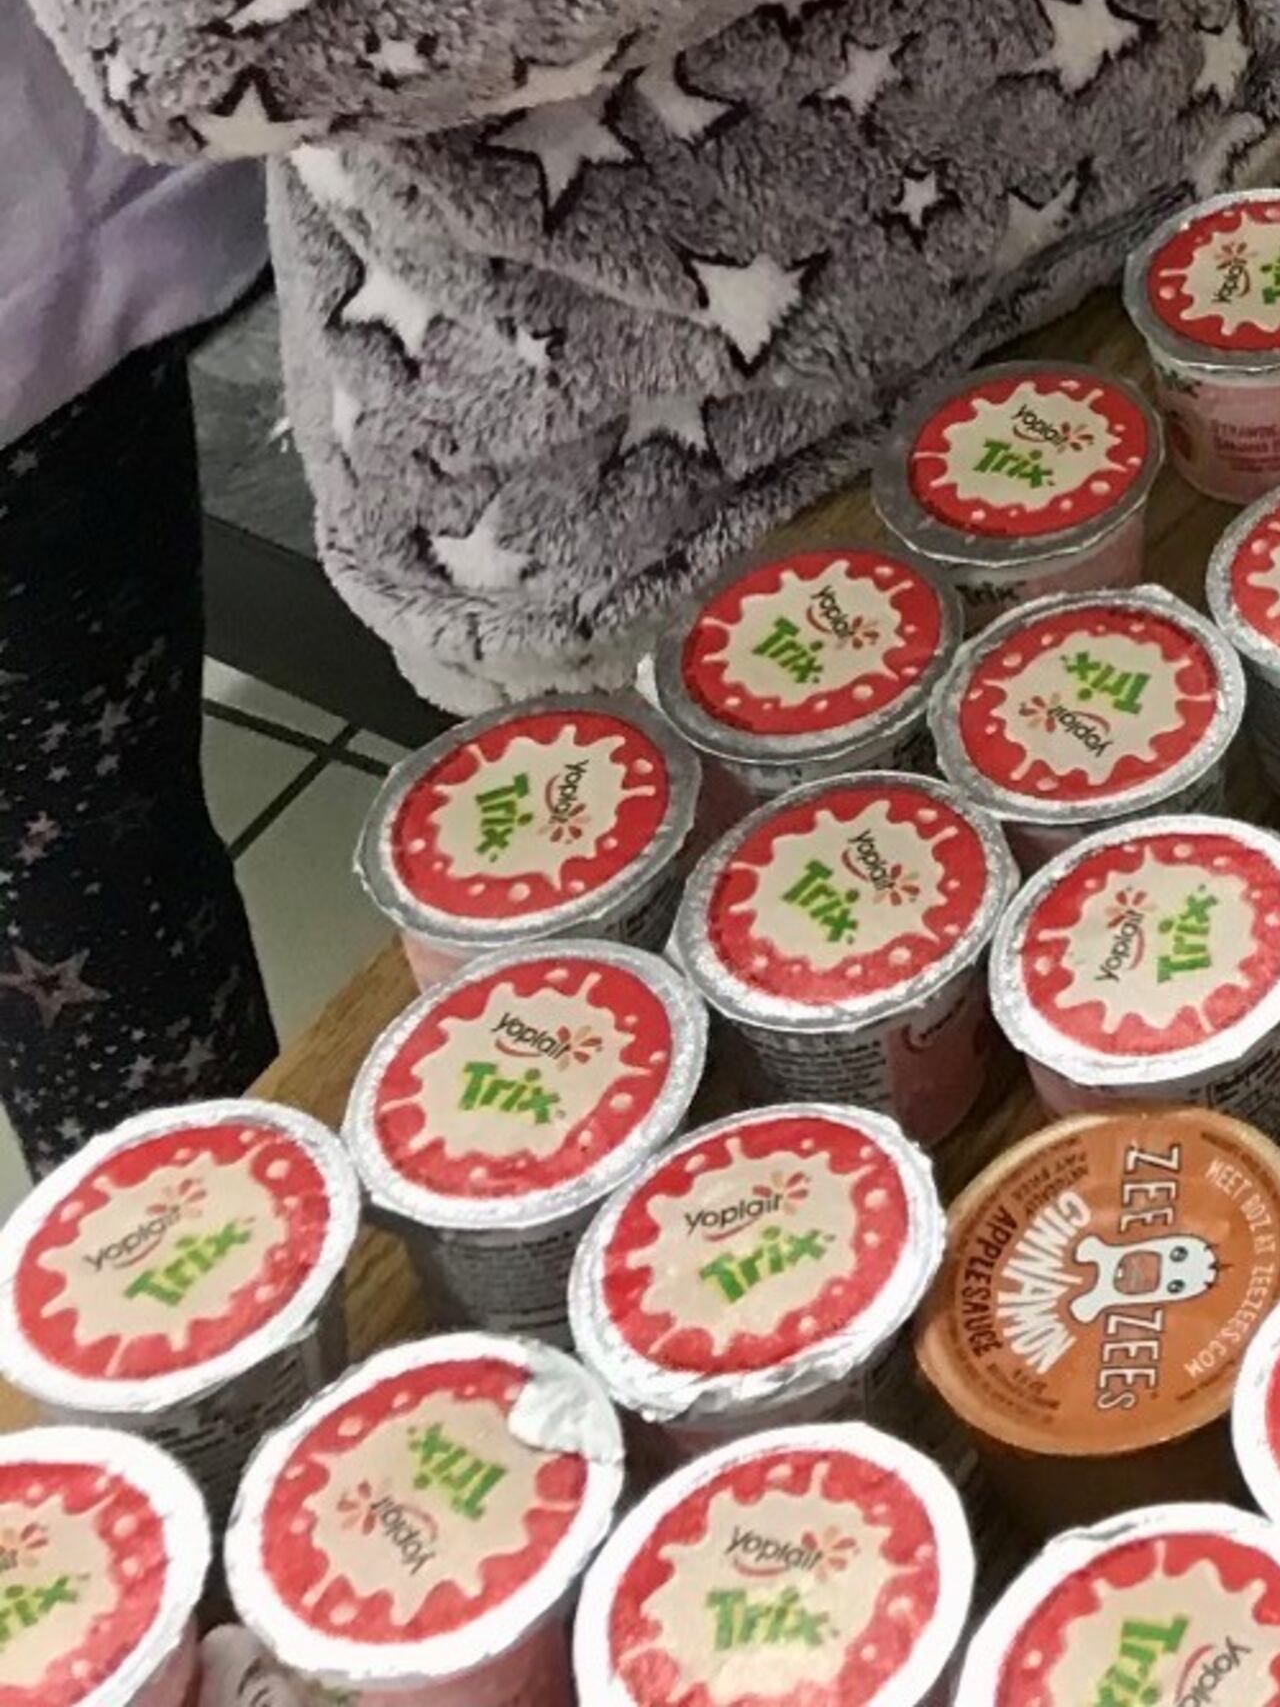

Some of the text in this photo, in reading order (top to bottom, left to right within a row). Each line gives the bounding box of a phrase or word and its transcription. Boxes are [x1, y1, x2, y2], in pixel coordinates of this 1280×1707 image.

[973, 440, 1049, 486] Trix
[756, 618, 819, 682] Trix
[1067, 652, 1149, 713] Trix
[476, 773, 530, 853] Trix
[785, 859, 857, 942] Trix
[1158, 894, 1214, 981] Trix
[459, 1062, 556, 1122] Trix
[1205, 1159, 1252, 1198] MEET
[1252, 1230, 1277, 1254] AT
[127, 1224, 247, 1303] Trix
[700, 1232, 823, 1302] Trix
[961, 1202, 1019, 1358] APPLESAUCE
[996, 1190, 1092, 1375] CINNAMON
[1097, 1140, 1181, 1410] ZEE ZEES
[413, 1427, 504, 1517] Trix
[705, 1585, 828, 1652] Trix
